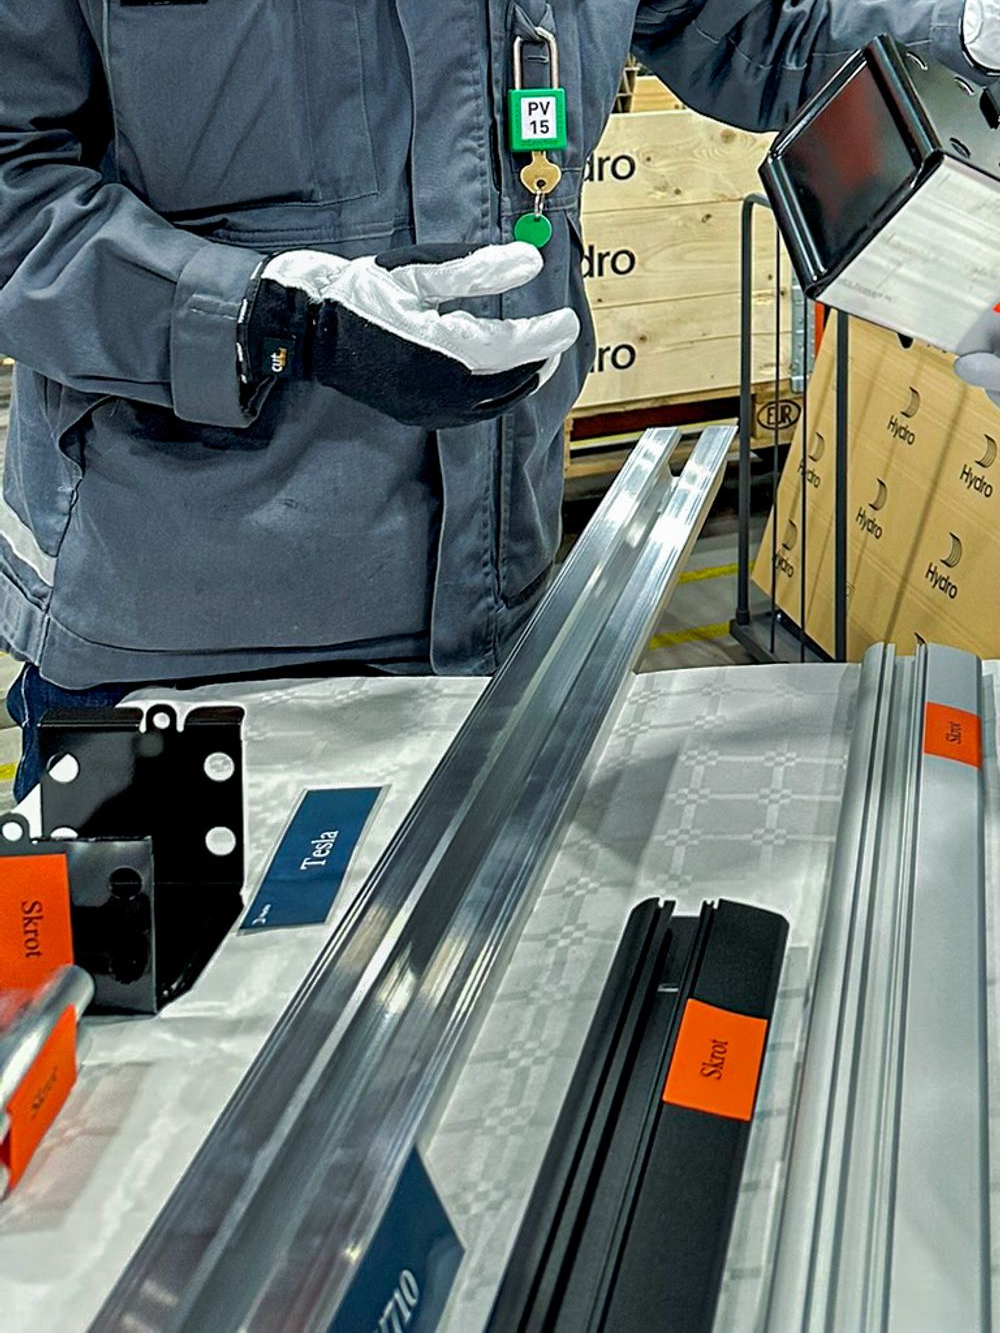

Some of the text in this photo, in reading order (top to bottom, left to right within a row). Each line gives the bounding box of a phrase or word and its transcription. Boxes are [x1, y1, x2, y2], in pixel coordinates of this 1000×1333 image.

[528, 101, 550, 116] PV
[529, 120, 549, 134] 15
[582, 243, 636, 279] dro
[767, 405, 792, 425] EUR
[887, 415, 916, 446] Hydro
[960, 464, 994, 498] Hydro
[855, 507, 883, 539] Hydro
[925, 562, 958, 599] Hydro
[946, 721, 961, 745] Skrot
[301, 829, 339, 870] Tesla
[21, 900, 42, 958] Skrot
[701, 1038, 728, 1080] Skrot
[374, 1269, 419, 1333] 710
